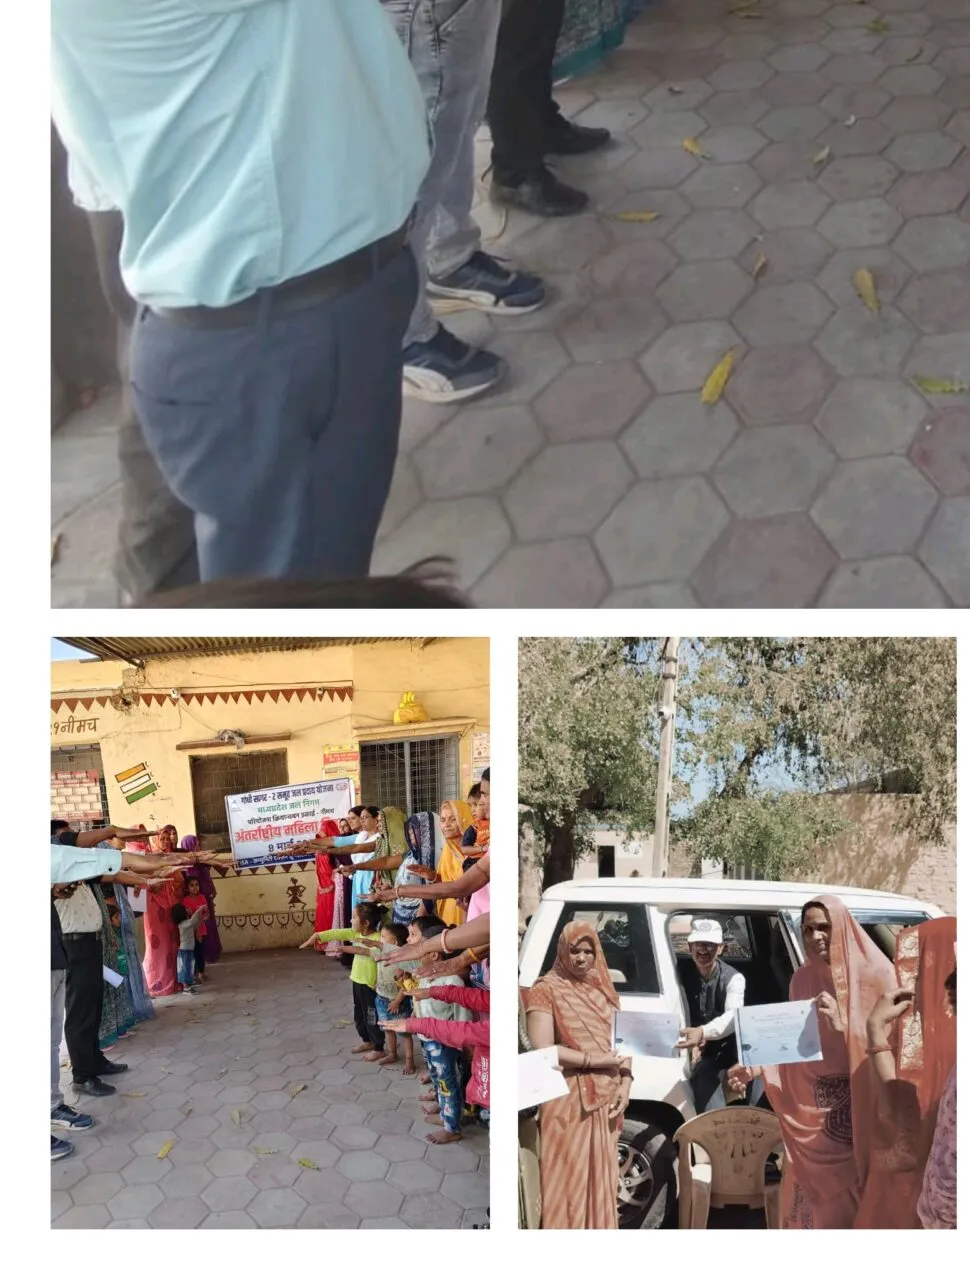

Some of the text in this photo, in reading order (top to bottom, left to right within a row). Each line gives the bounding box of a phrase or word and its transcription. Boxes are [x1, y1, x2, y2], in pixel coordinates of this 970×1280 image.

[61, 715, 100, 734] नीमच
[258, 803, 287, 813] मध्यप्रदेश
[289, 801, 301, 809] जल
[283, 821, 318, 835] महिला
